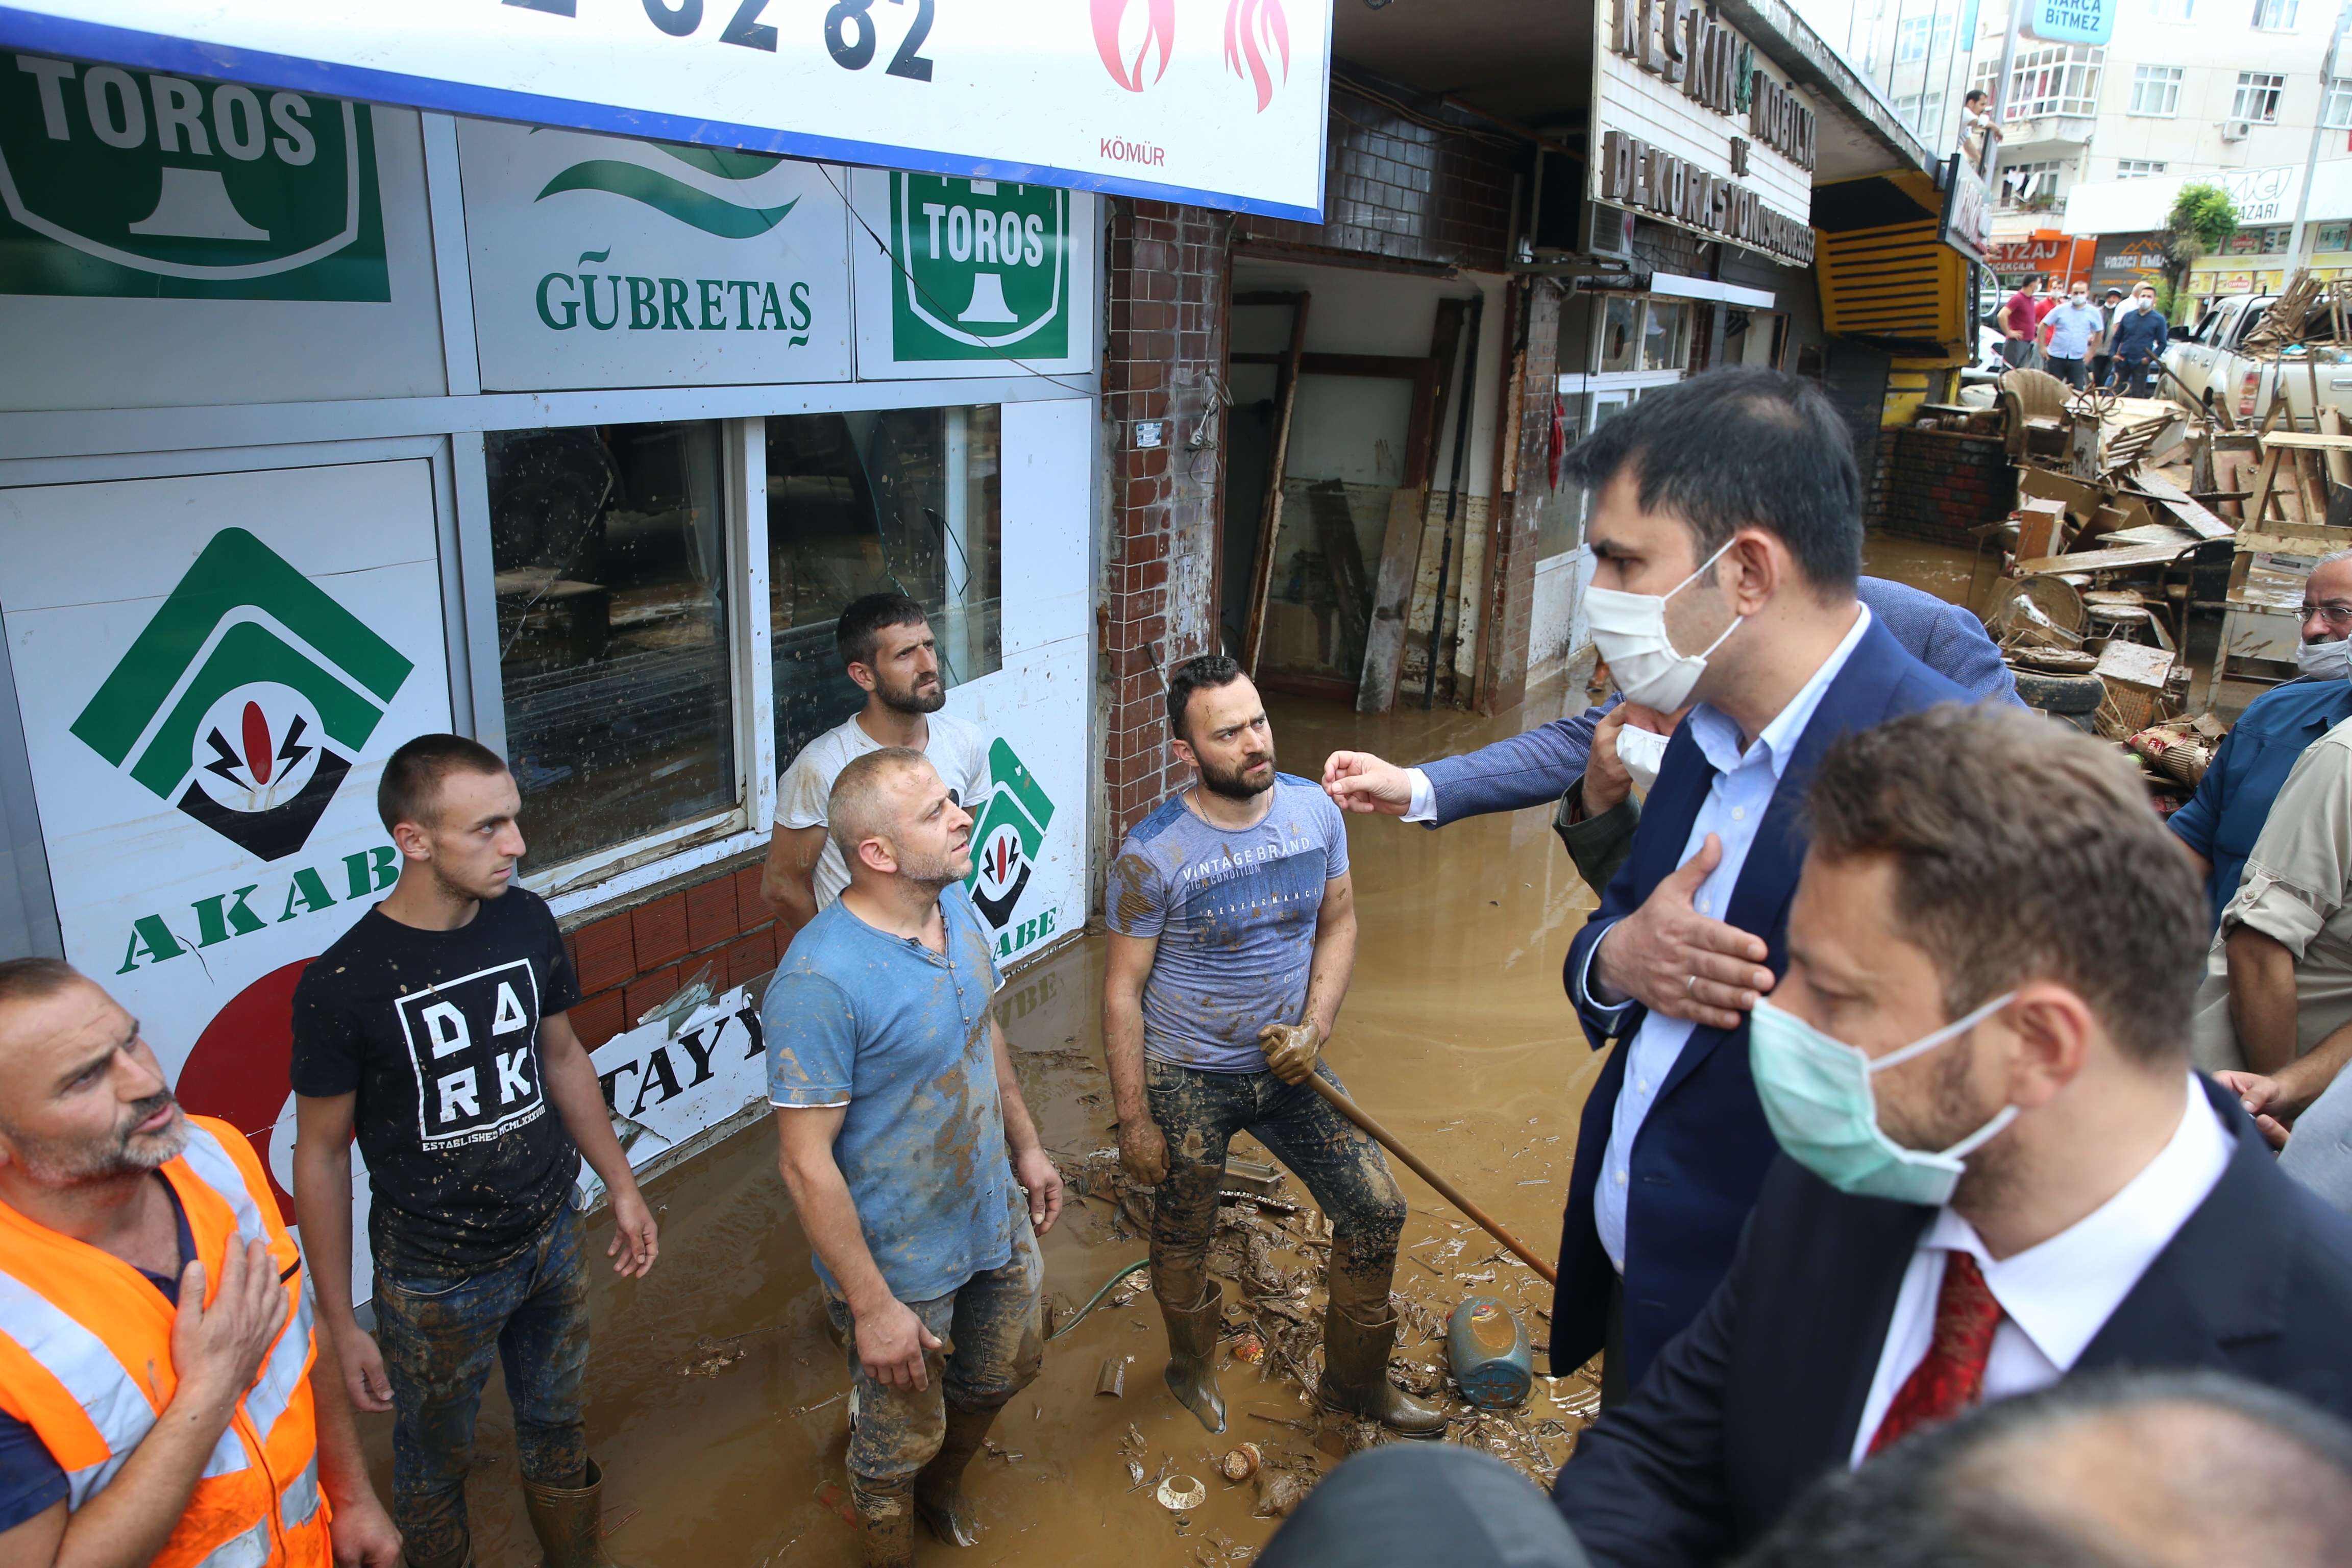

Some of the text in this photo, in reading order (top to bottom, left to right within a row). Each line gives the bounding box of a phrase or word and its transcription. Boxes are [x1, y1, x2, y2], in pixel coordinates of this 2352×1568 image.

[15, 54, 316, 166] TOROS
[1100, 135, 1165, 167] KÖMÜR
[1729, 136, 1751, 177] VE
[1602, 131, 1759, 244] DEKORASYON
[2238, 202, 2279, 220] AZARI
[922, 202, 1044, 268] TOROS
[1991, 242, 2057, 260] EYZAJ
[535, 245, 812, 350] GÜBRETAŞ
[1182, 837, 1310, 881] VINTAGE BRAND
[1210, 863, 1262, 885] CONDITION
[1207, 888, 1318, 917] PERFORMANCE
[422, 1104, 546, 1152] ESTABLISHED MCMLXXXVIII
